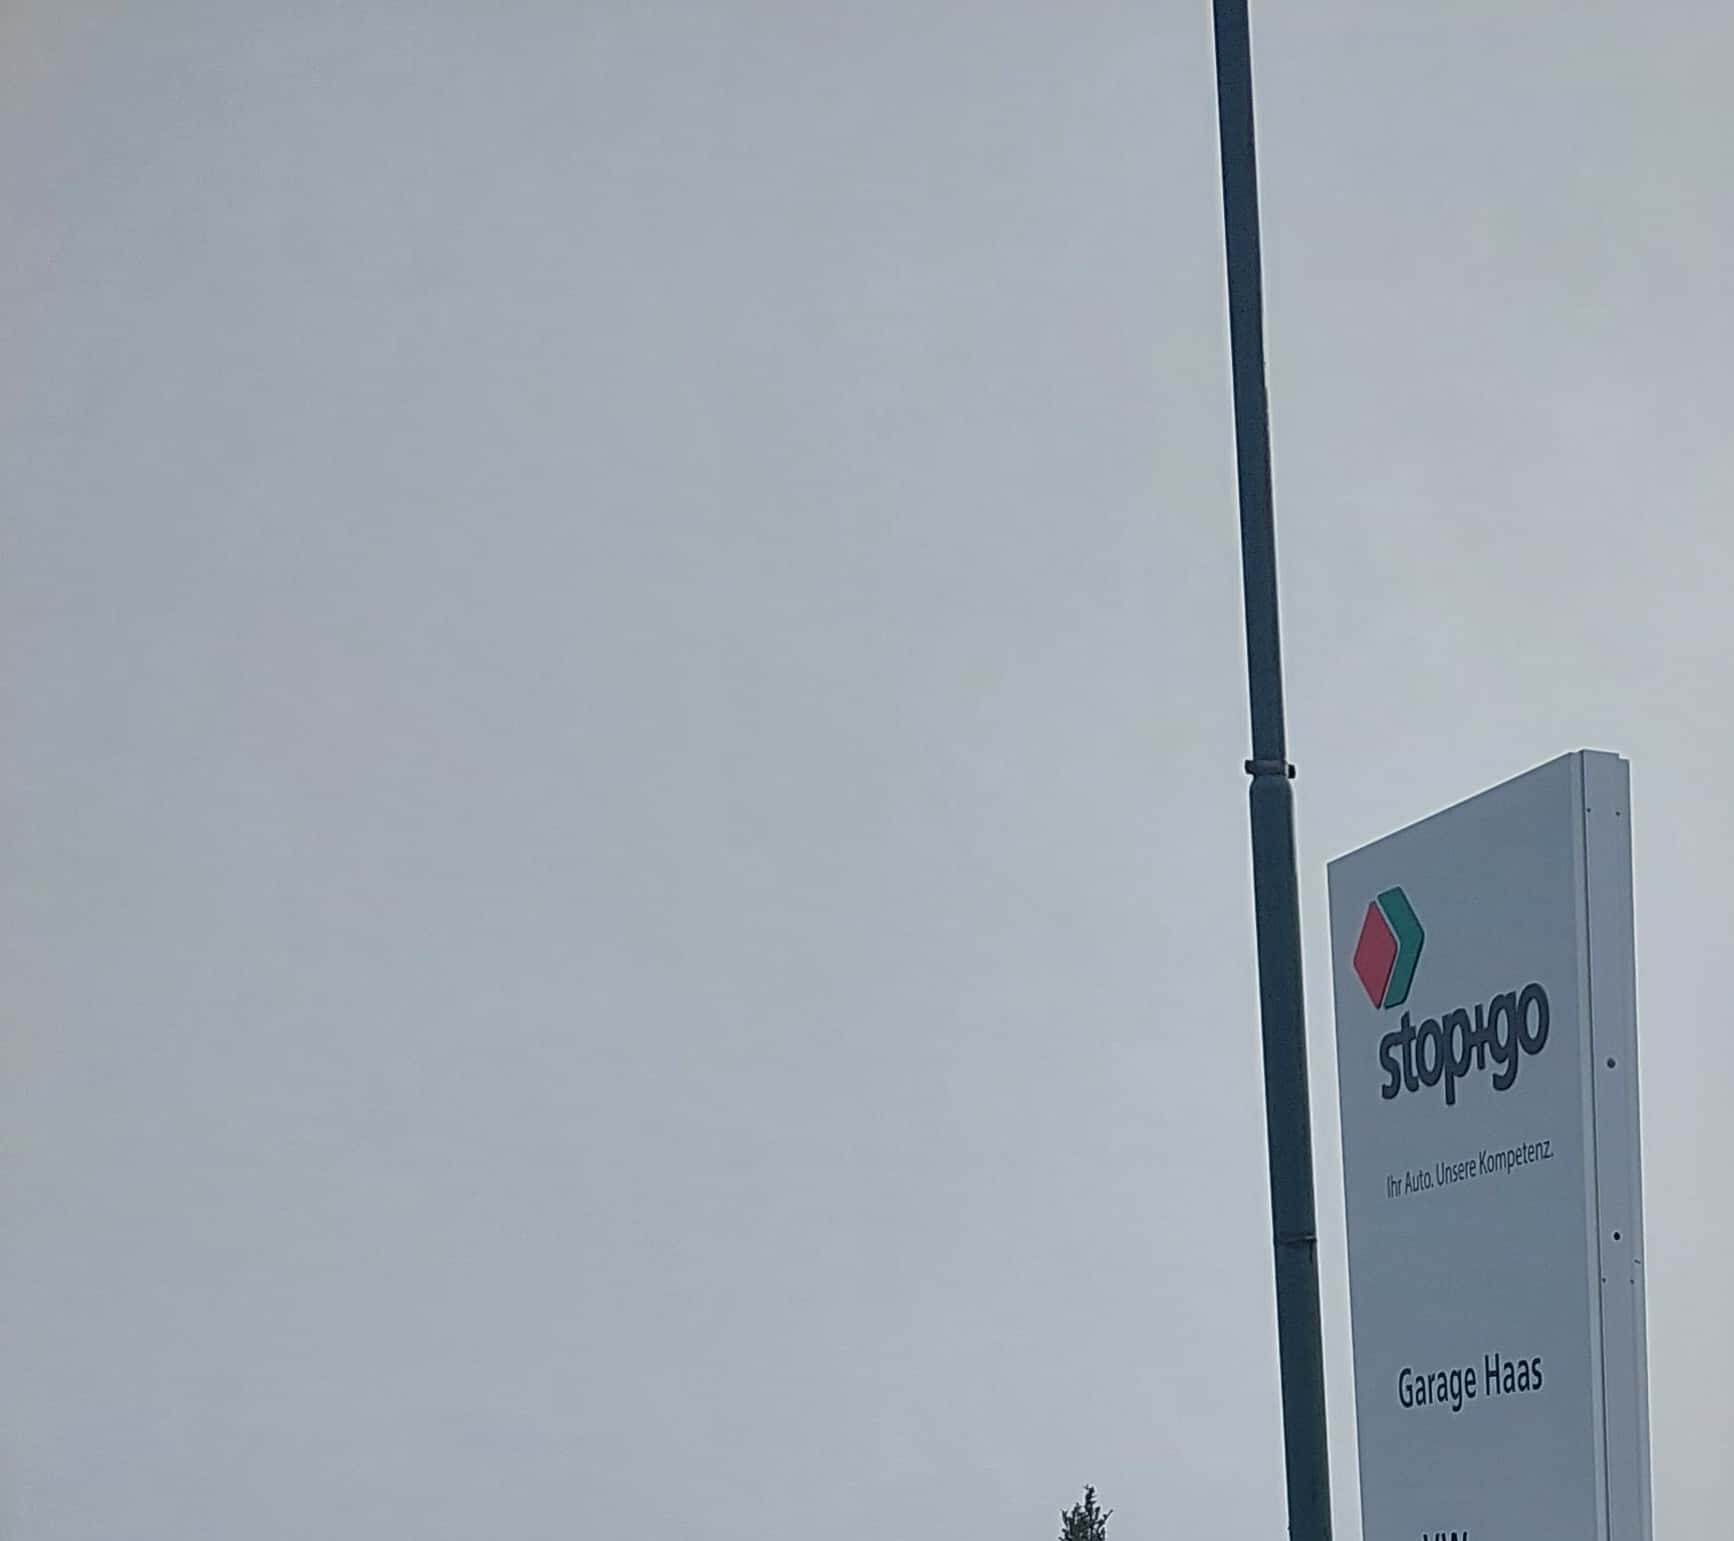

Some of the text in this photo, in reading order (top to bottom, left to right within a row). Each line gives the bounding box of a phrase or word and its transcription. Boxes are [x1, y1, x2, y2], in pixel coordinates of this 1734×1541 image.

[1379, 982, 1550, 1105] stop+go
[1386, 1139, 1555, 1199] Ihr Auto. Unsere Kompetenz.
[1398, 1352, 1544, 1412] Garage Haas
